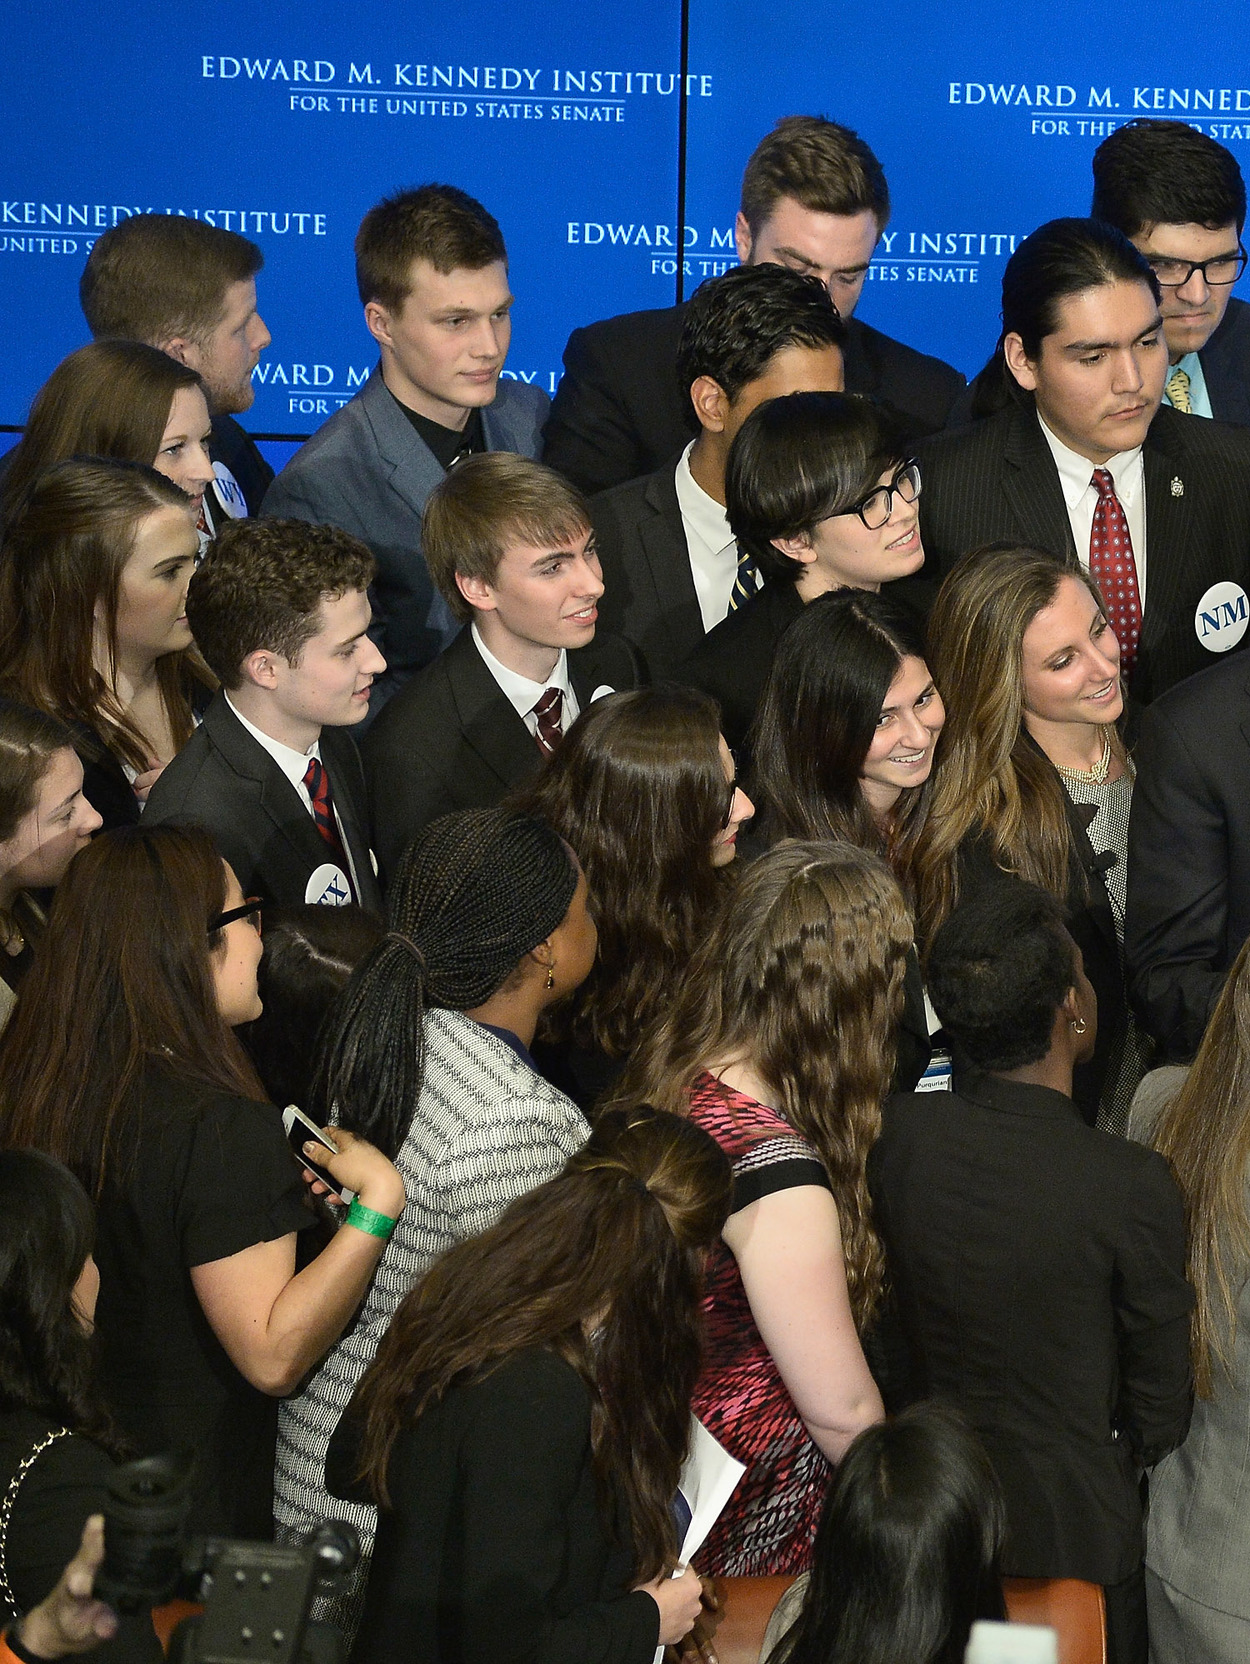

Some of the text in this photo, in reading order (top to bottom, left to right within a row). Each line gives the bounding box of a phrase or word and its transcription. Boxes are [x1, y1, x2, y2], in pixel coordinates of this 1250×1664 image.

[202, 55, 713, 97] EDWARD M. KENNEDY INSTITUTE
[948, 82, 1077, 107] EDWARD
[1087, 86, 1120, 108] M.
[290, 95, 625, 122] FOR THE UNITED STATES SENATE
[1031, 119, 1071, 136] FOR
[1076, 120, 1116, 137] THE
[567, 222, 698, 247] EDWARD
[906, 266, 978, 283] SENATE
[289, 398, 329, 414] FOR
[1199, 594, 1248, 637] NM
